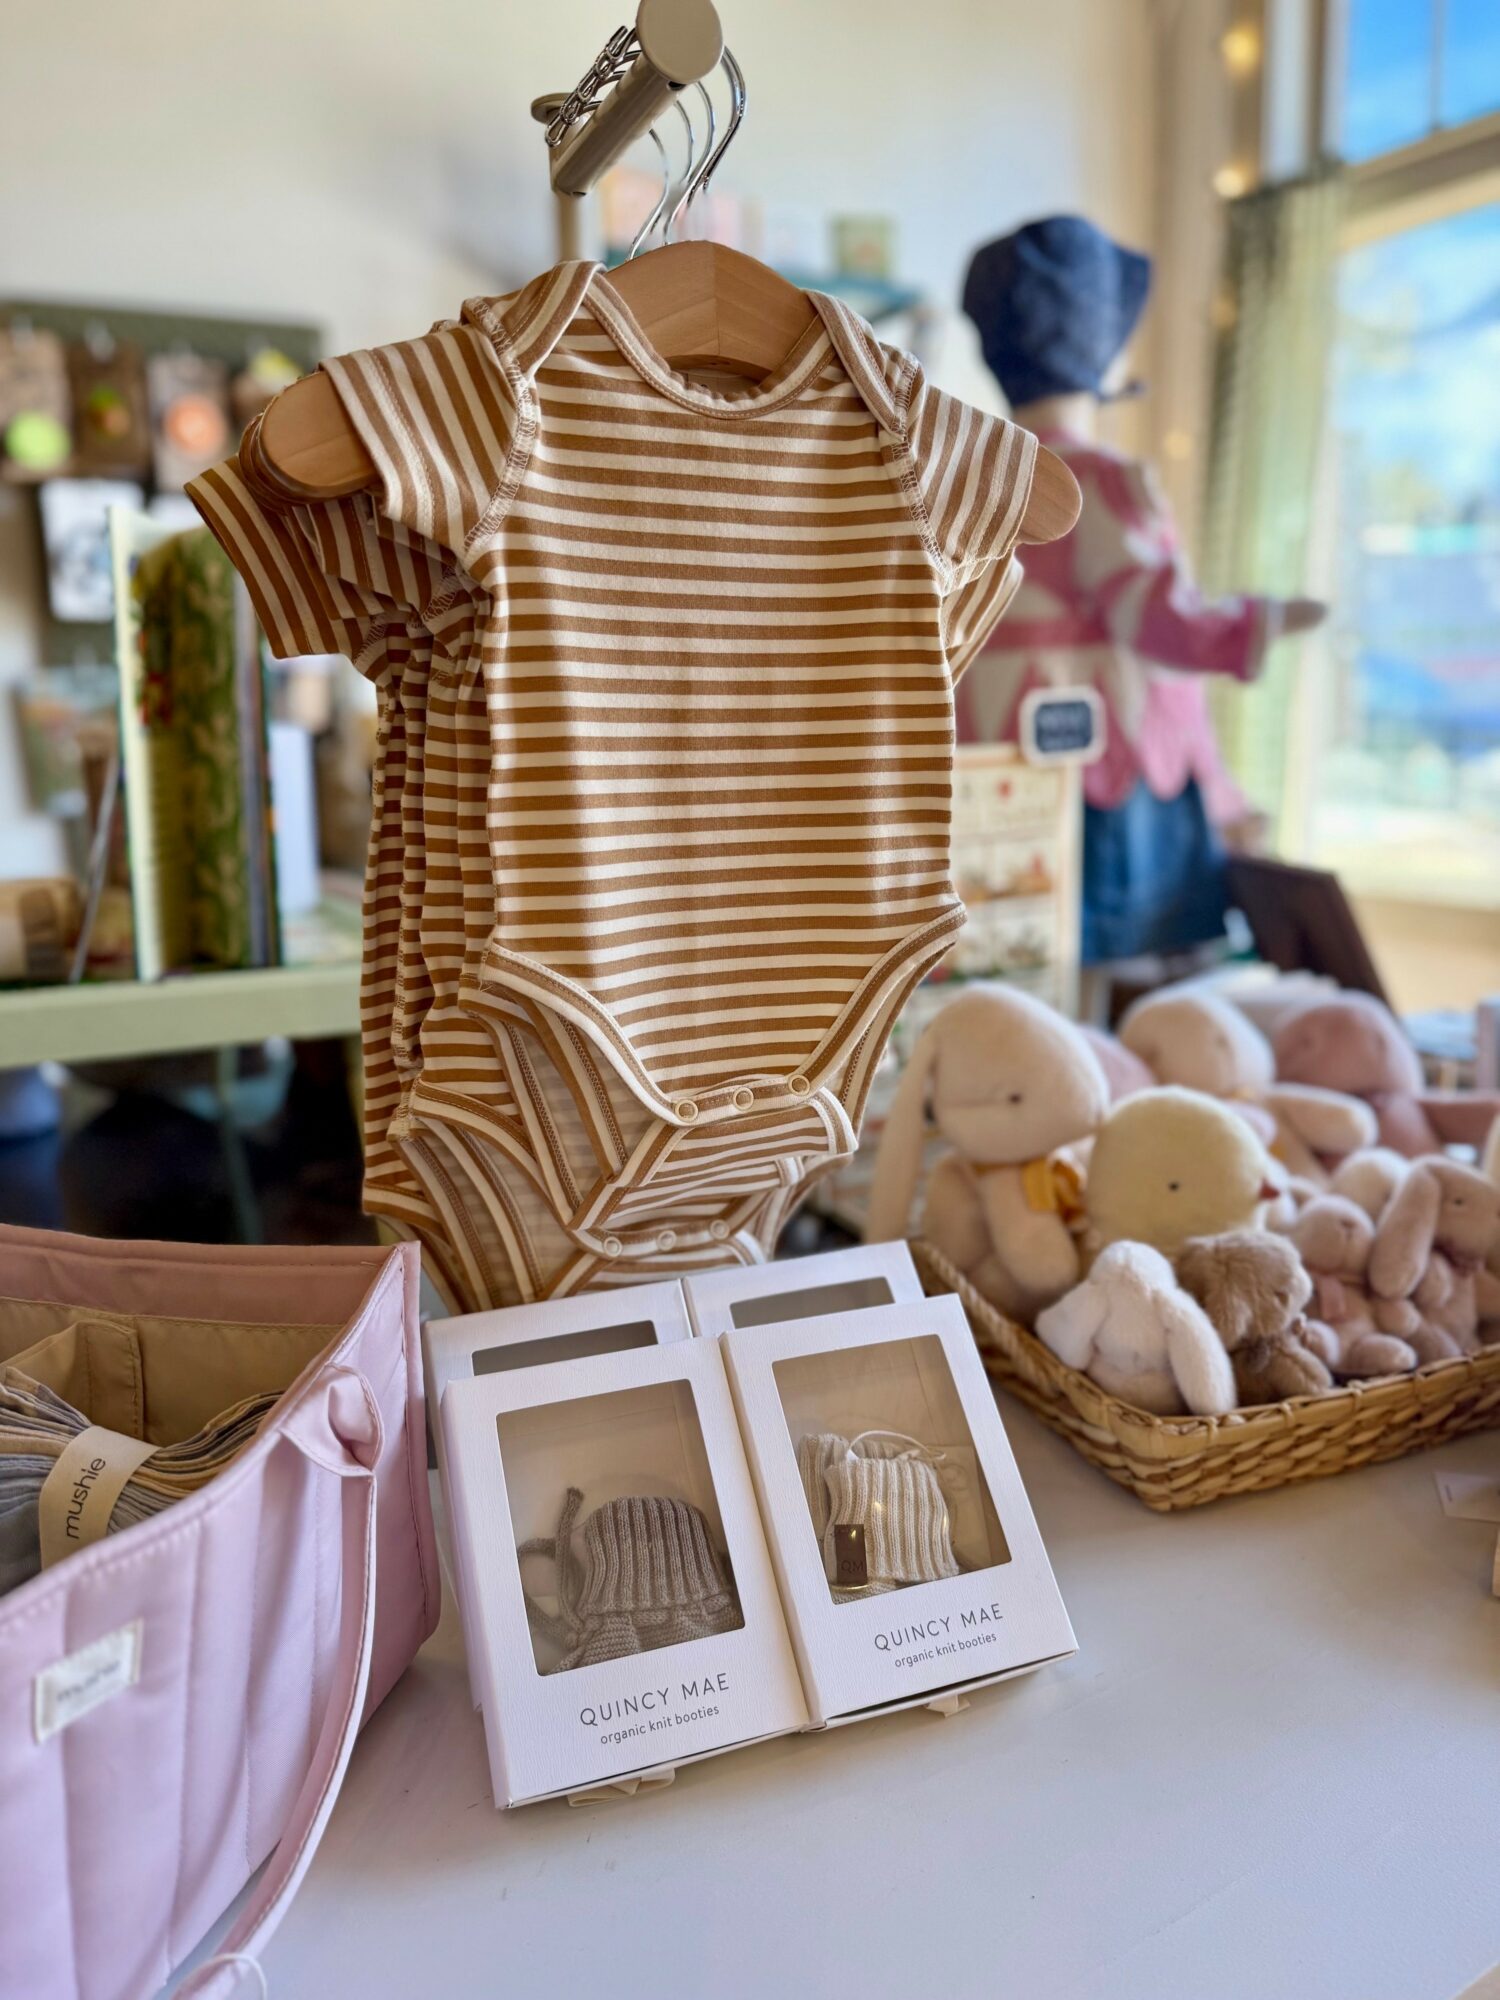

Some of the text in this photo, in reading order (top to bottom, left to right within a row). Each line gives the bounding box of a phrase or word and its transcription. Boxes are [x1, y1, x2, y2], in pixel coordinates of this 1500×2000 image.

[66, 1458, 106, 1540] mushie
[874, 1603, 1003, 1652] QUINCY MAE
[894, 1632, 997, 1668] organic knit booties
[580, 1672, 729, 1727] QUINCY MAE
[600, 1705, 720, 1745] organic knit booties
